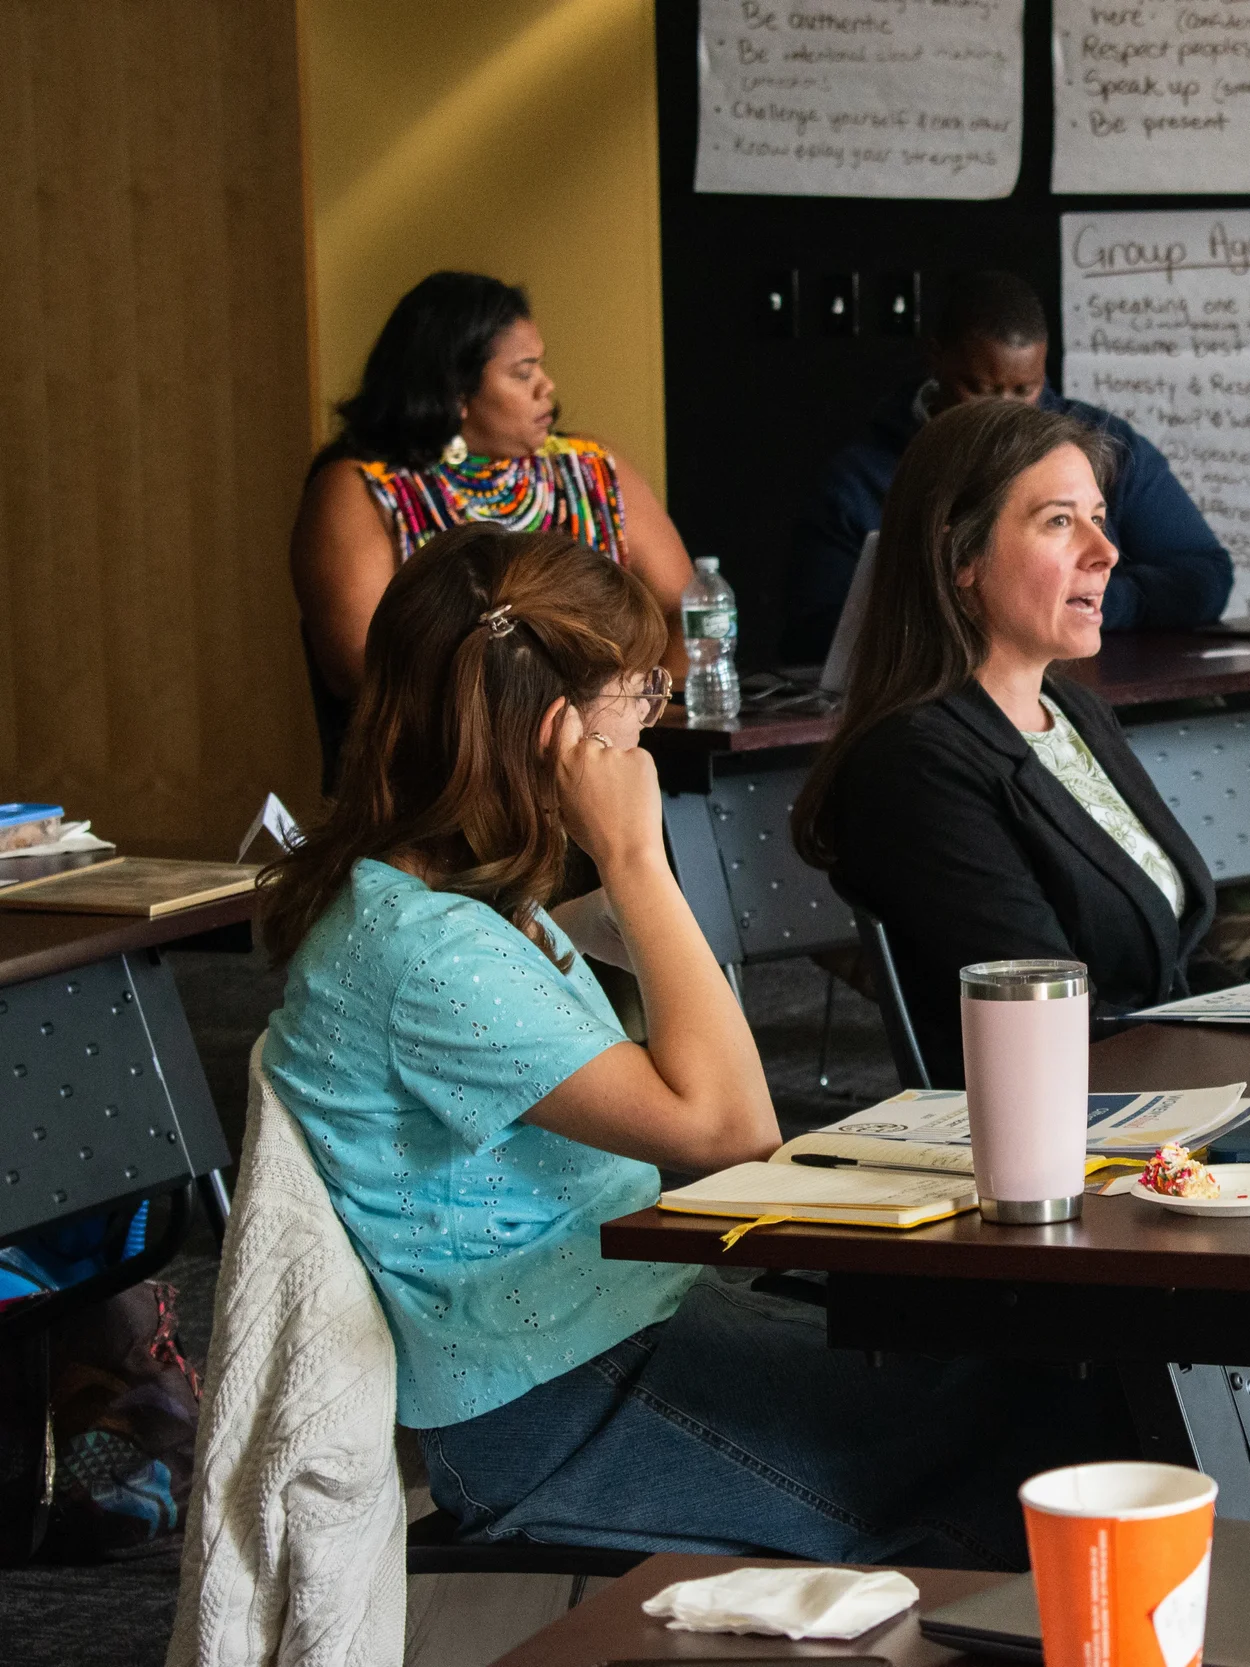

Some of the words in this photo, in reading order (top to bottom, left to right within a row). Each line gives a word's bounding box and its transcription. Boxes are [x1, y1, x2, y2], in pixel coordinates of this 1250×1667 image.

[741, 1, 778, 31] Be
[787, 13, 894, 35] authentic
[737, 38, 769, 65] Be
[1082, 36, 1169, 66] Respect
[1084, 69, 1163, 104] Speak
[1168, 81, 1201, 105] up
[732, 101, 820, 136] Challenge
[827, 109, 909, 133] yourself
[1090, 111, 1127, 137] Be
[1142, 111, 1230, 140] present
[851, 148, 892, 169] your
[1071, 223, 1188, 284] Group
[1087, 295, 1189, 325] Speaking
[1203, 299, 1241, 314] one
[1090, 329, 1181, 357] Assume
[1191, 334, 1247, 357] best
[1091, 371, 1178, 400] Honesty
